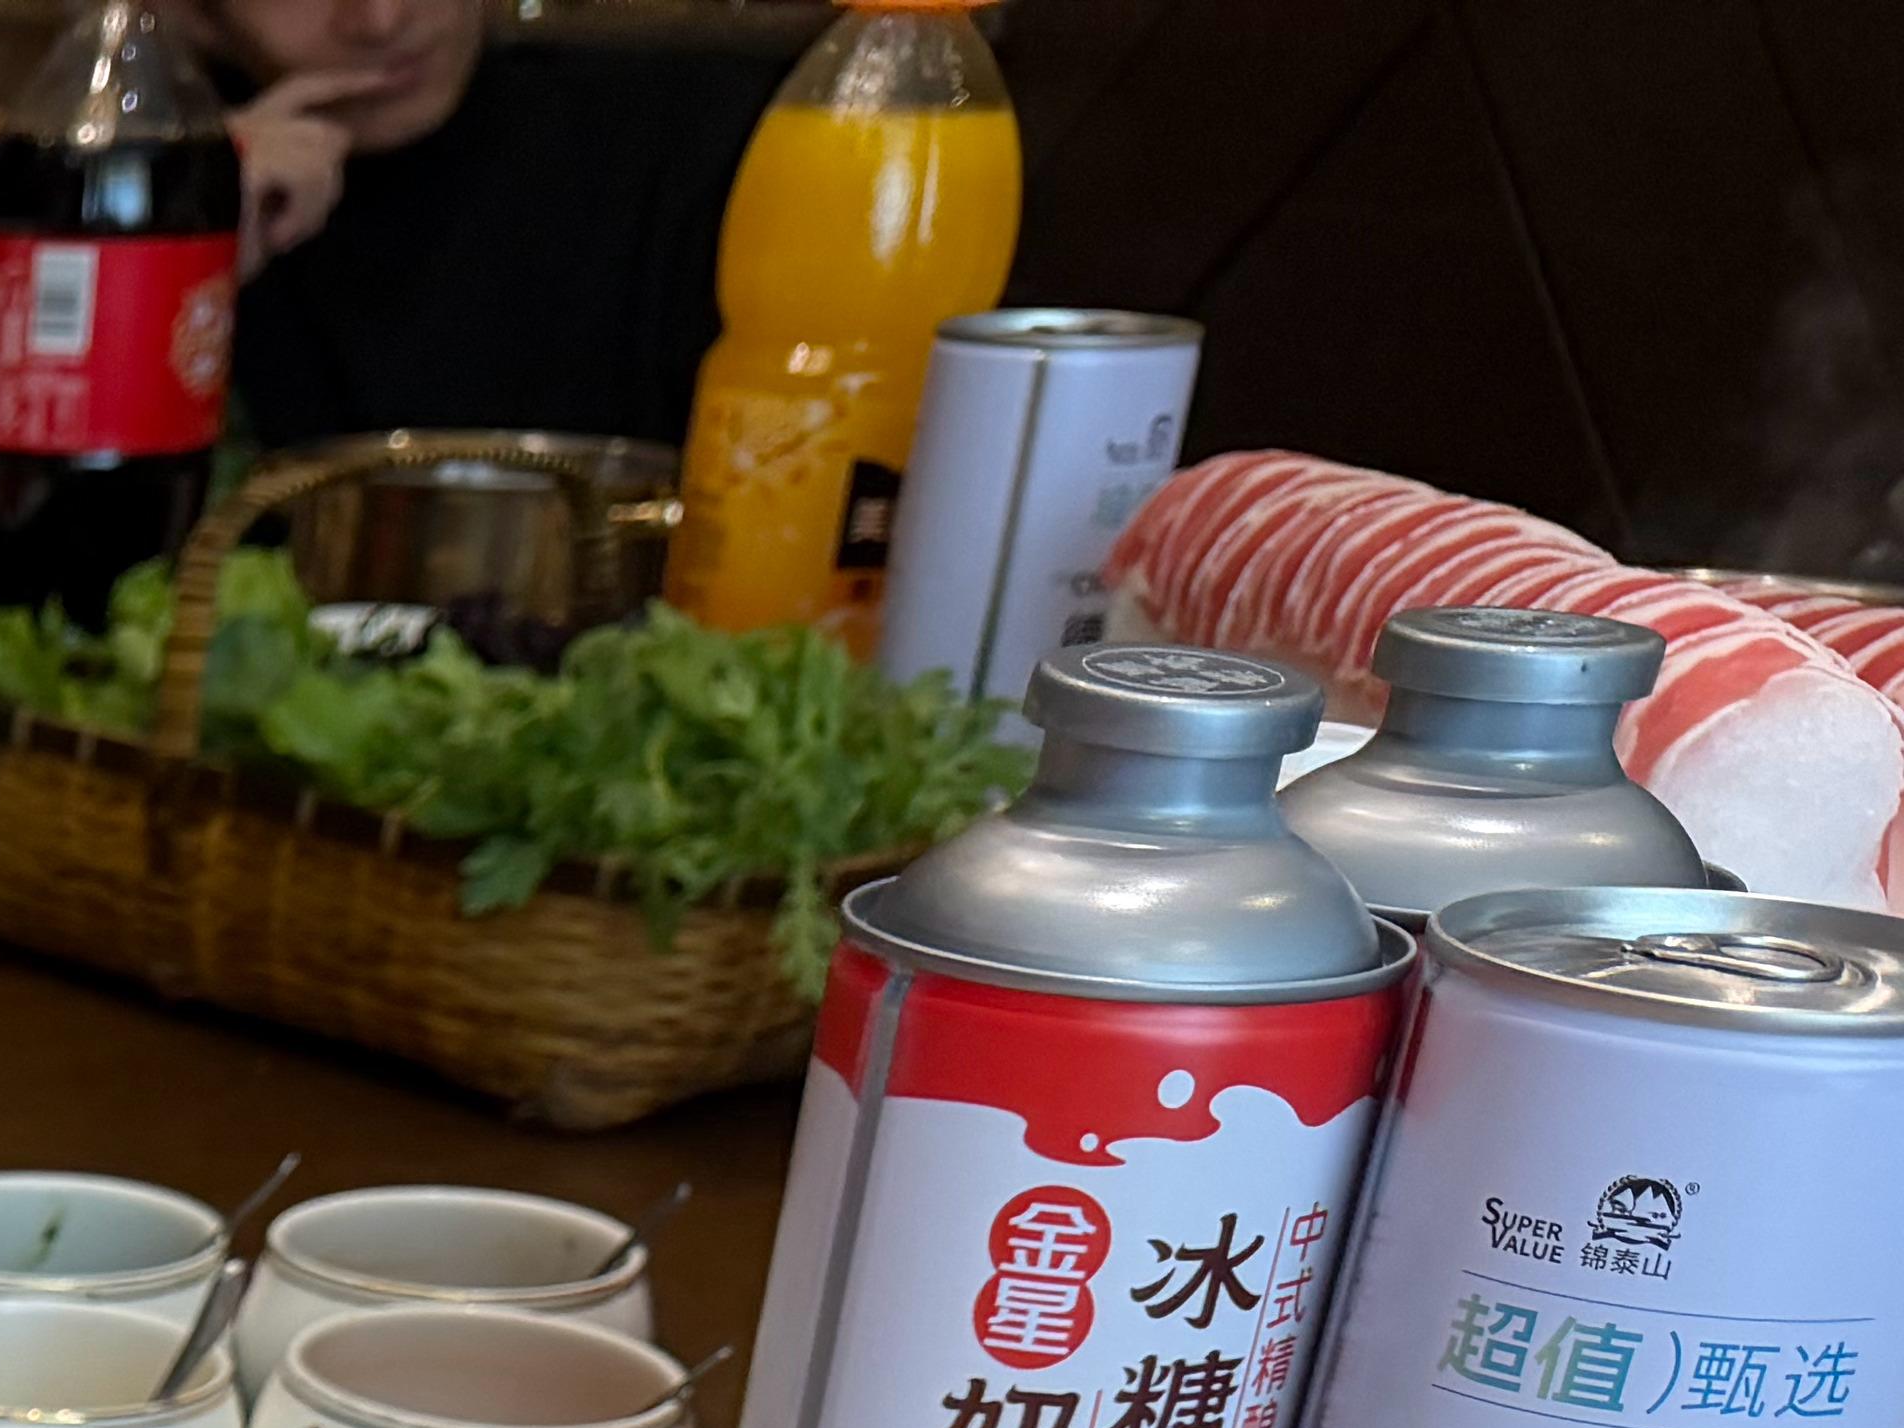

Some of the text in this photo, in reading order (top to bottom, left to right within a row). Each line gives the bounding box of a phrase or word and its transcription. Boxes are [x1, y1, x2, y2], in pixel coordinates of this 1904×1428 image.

[1481, 1197, 1563, 1243] SUPER
[1490, 1224, 1565, 1264] VALUE
[1580, 1242, 1672, 1281] 锦泰山
[983, 1201, 1098, 1356] 金星
